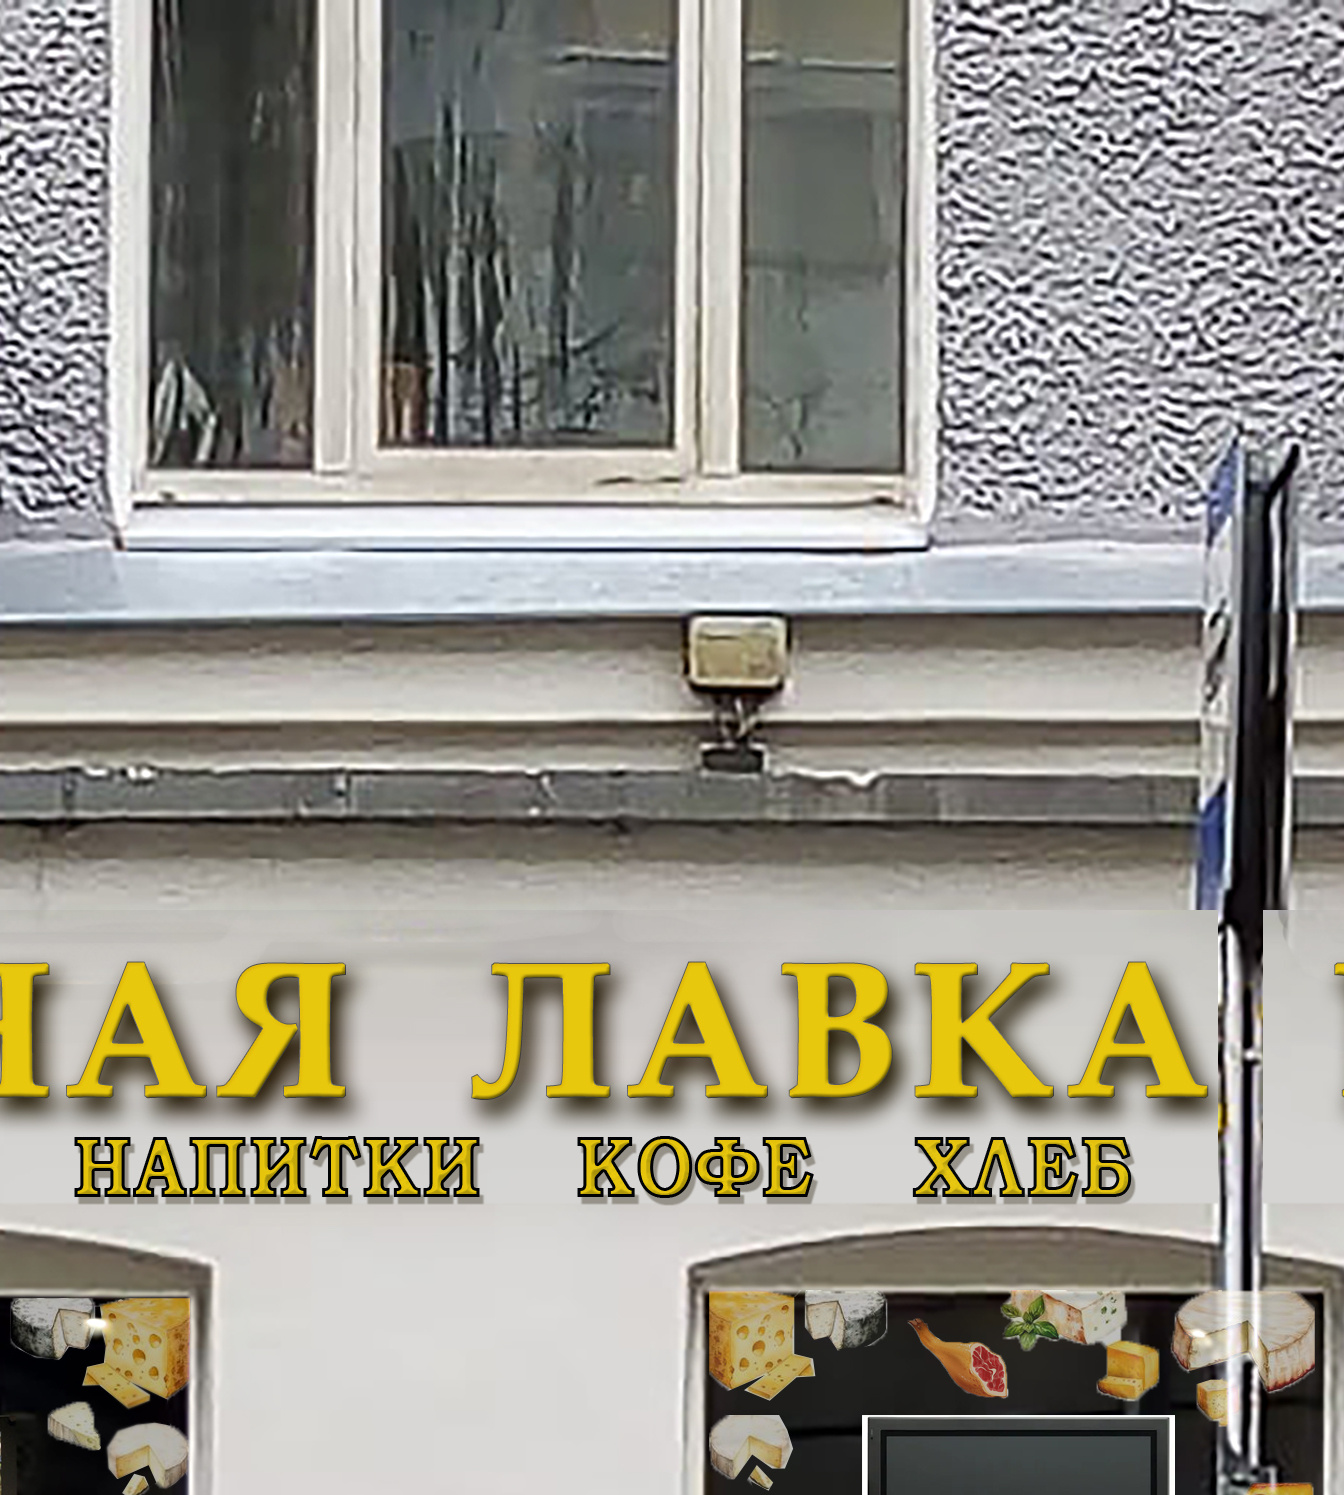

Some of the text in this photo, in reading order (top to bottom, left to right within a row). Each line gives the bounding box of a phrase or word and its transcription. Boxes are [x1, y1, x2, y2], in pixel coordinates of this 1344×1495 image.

[471, 961, 1208, 1100] ЛАВКА
[74, 1136, 480, 1198] НАПИТКИ
[577, 1136, 814, 1198] КОФЕ
[913, 1136, 1132, 1198] ХЛЕБ
